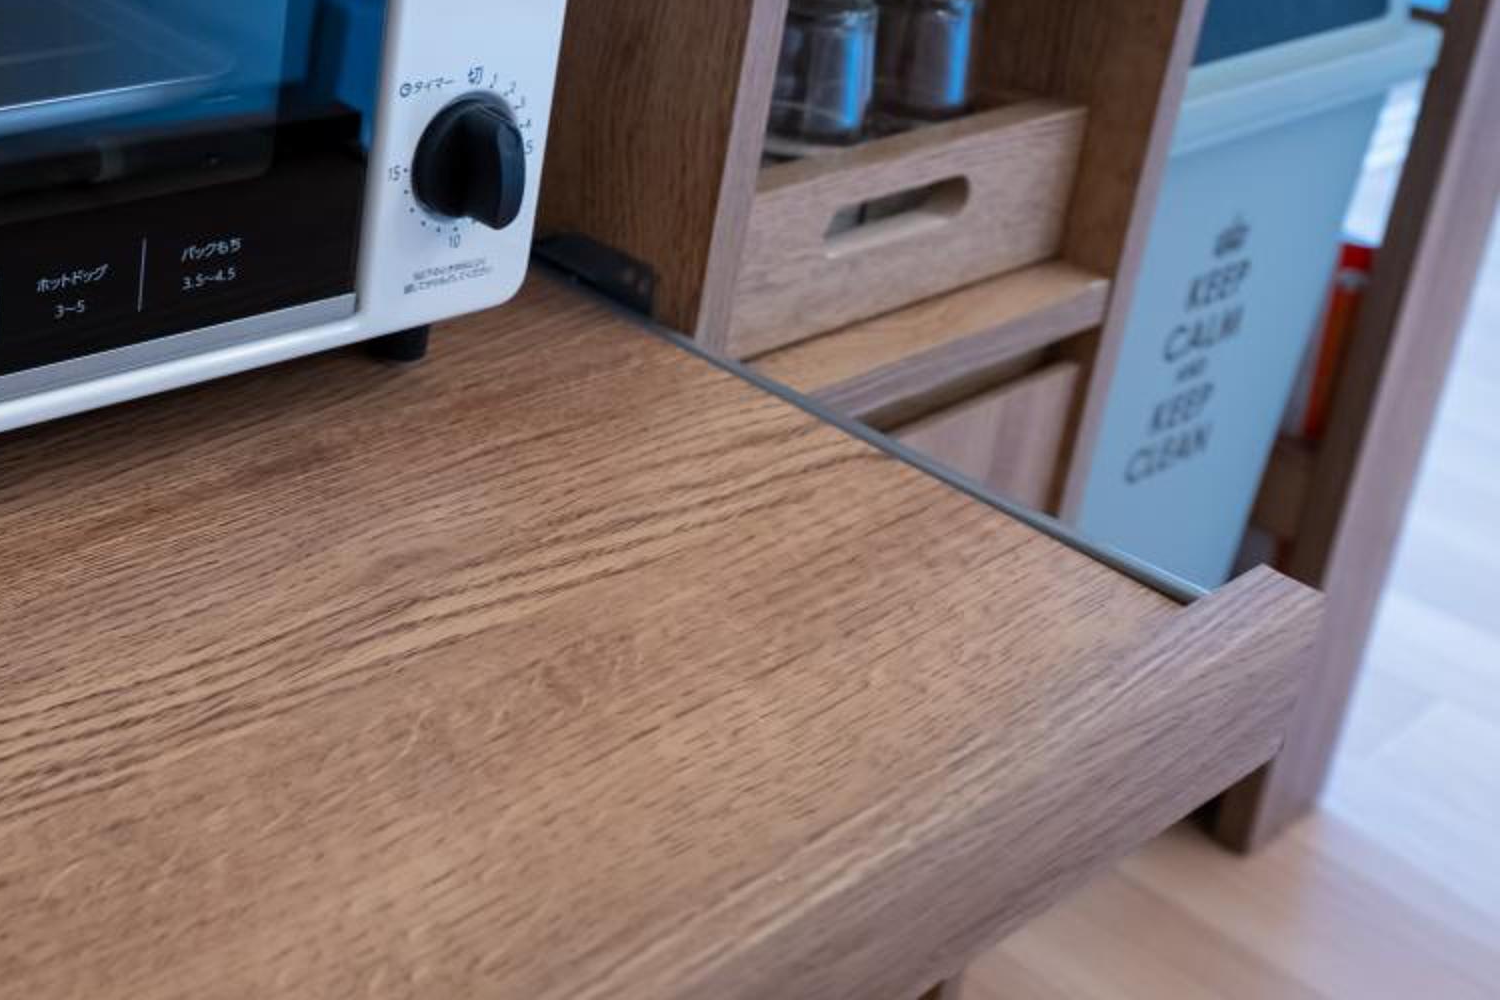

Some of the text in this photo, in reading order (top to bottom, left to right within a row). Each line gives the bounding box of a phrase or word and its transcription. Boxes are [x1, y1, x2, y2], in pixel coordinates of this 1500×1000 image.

[414, 77, 454, 93] タイマー
[467, 66, 483, 86] 切
[389, 166, 402, 181] 15
[181, 238, 242, 262] パックもち
[448, 234, 461, 248] 10
[36, 263, 109, 292] ホットドッグ
[1185, 260, 1251, 312] KEEP
[1163, 304, 1244, 364] CALM
[1147, 381, 1214, 437] KEEP
[1124, 423, 1212, 484] CLEAN
